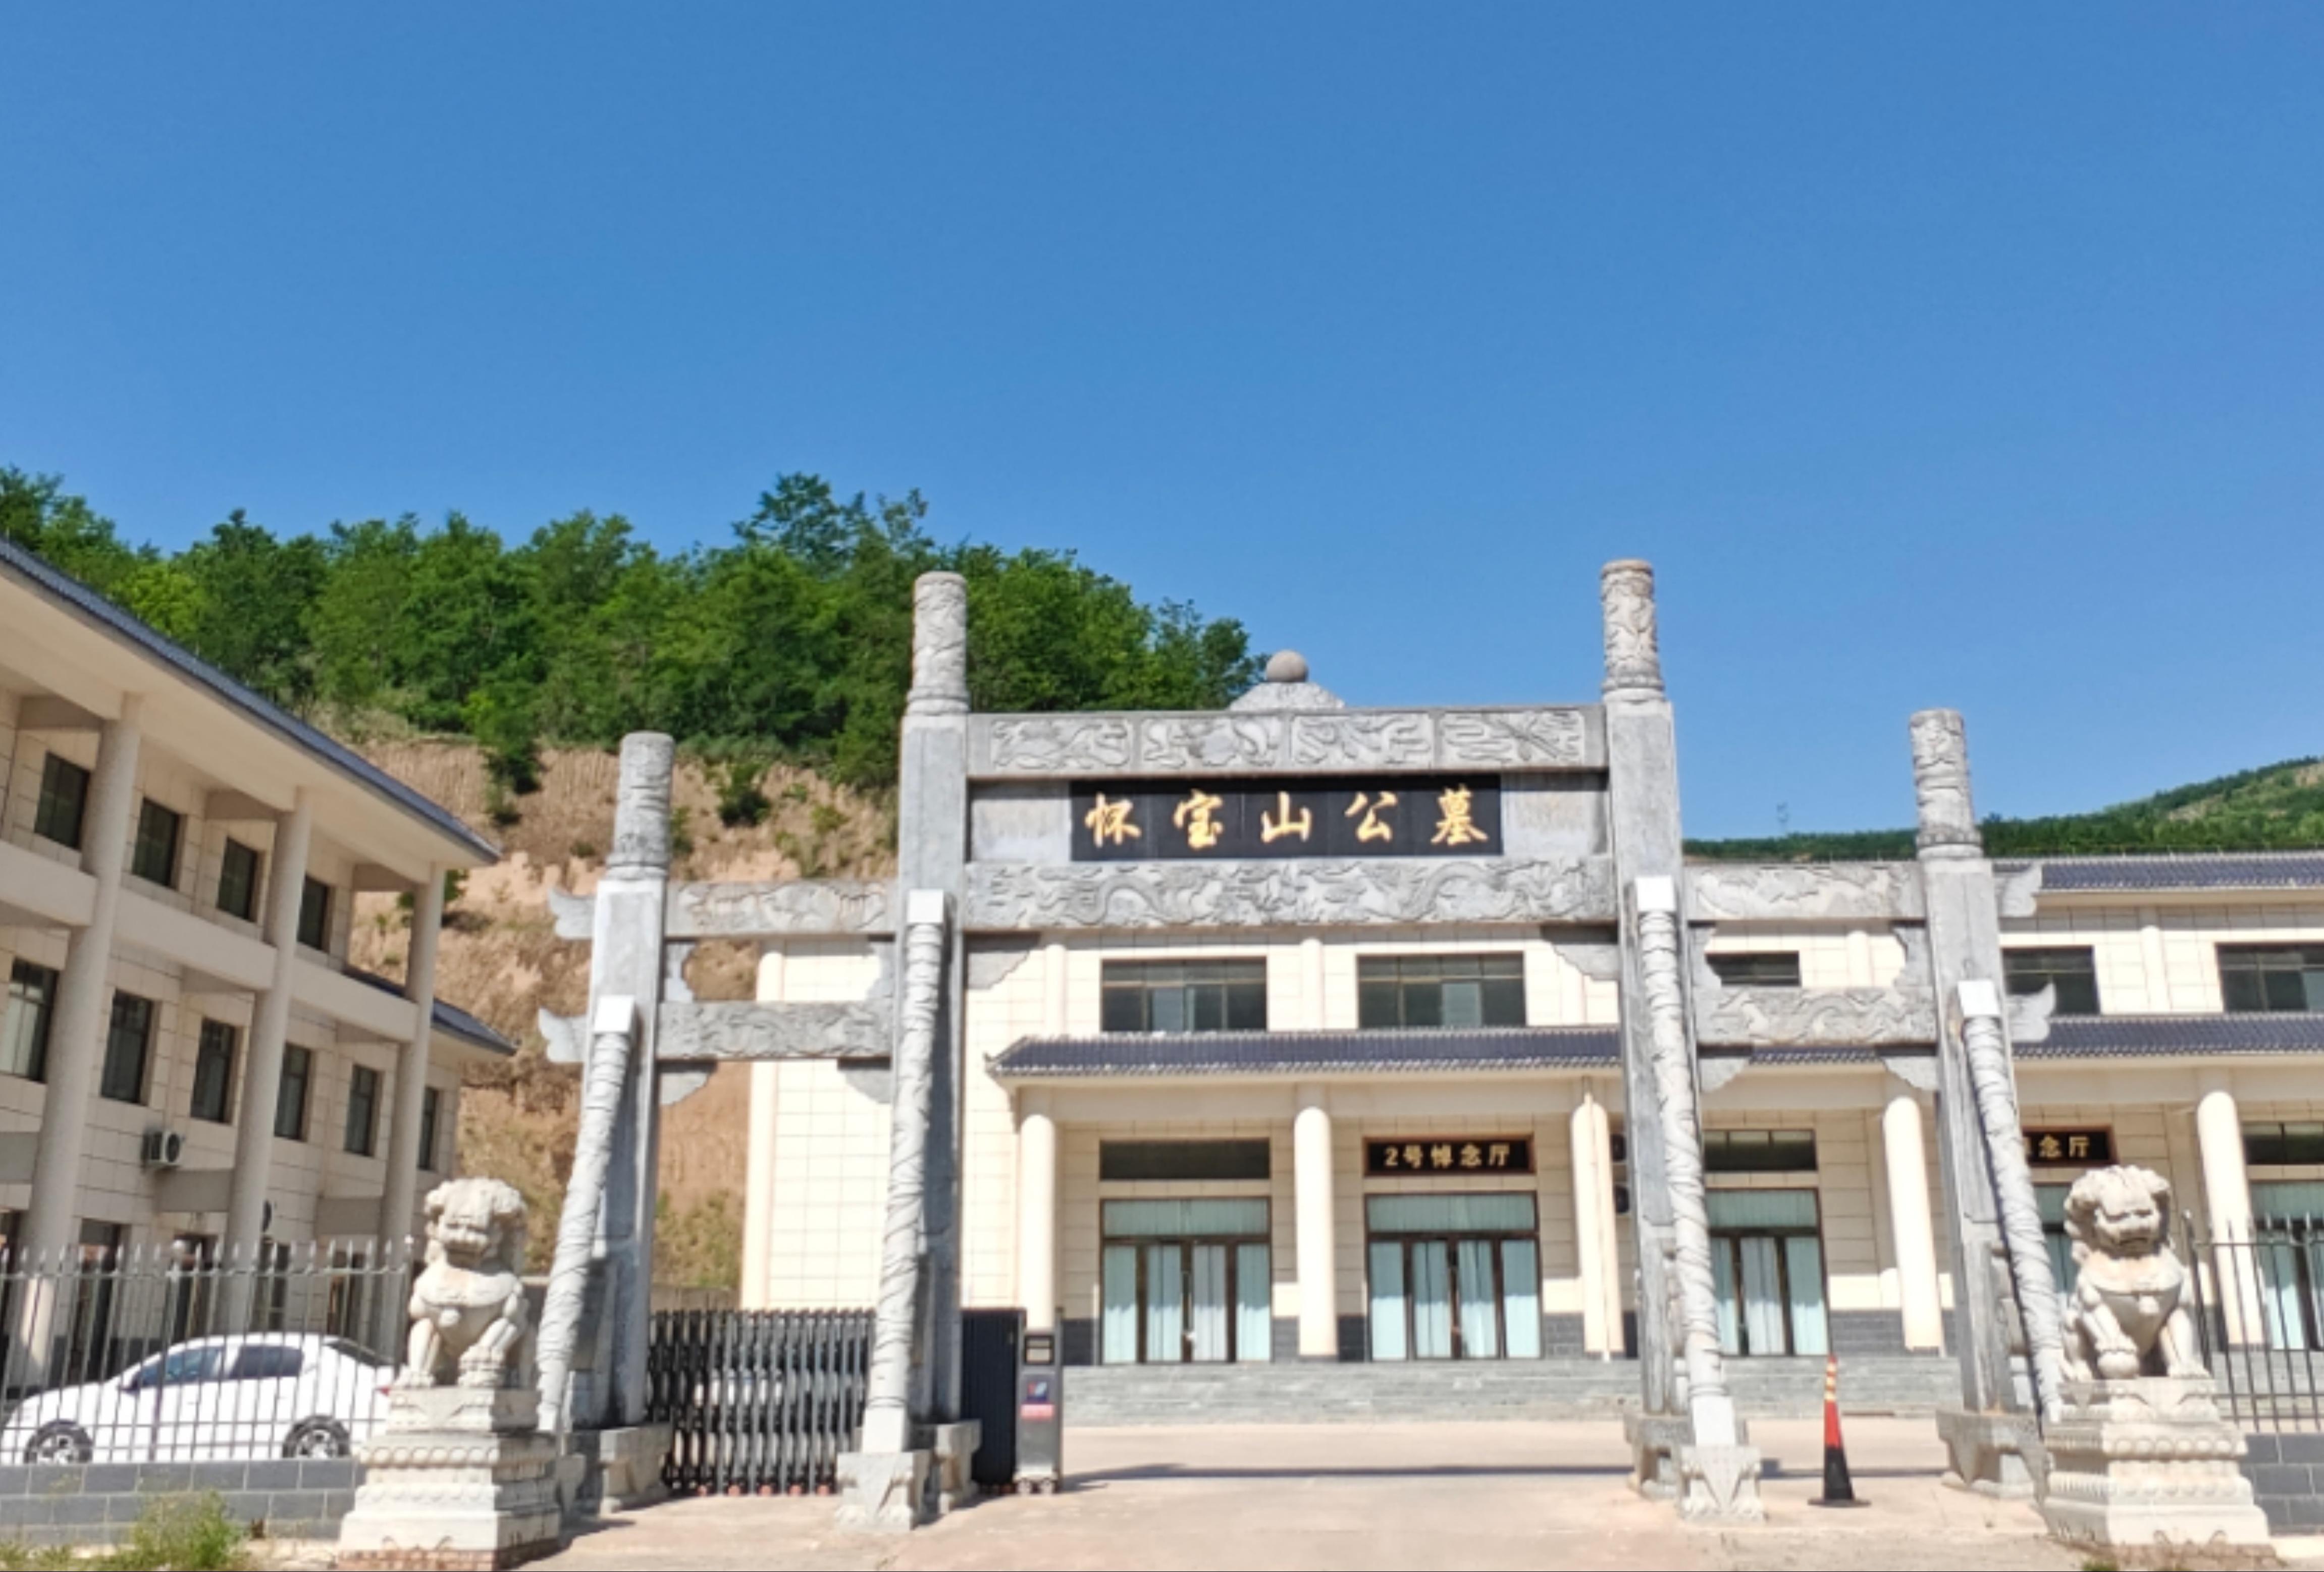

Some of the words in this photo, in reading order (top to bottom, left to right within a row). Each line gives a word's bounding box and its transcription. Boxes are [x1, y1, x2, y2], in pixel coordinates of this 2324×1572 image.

[1084, 785, 1488, 849] 怀宝山公墓
